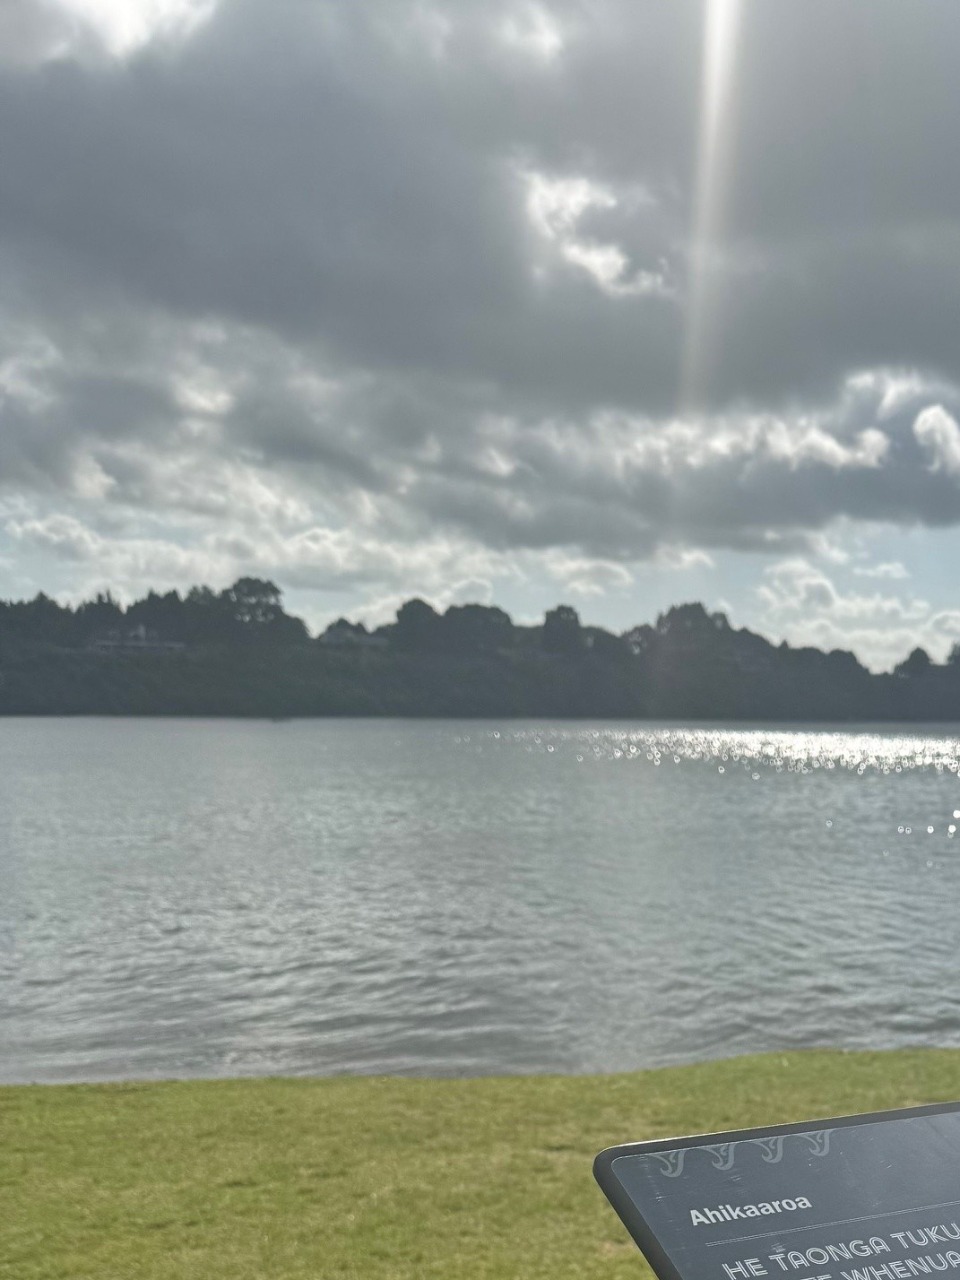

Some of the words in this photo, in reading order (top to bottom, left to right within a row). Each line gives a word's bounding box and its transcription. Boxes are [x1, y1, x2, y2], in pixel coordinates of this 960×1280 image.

[690, 1197, 812, 1226] Ahikaaroa
[721, 1258, 768, 1280] HE
[768, 1236, 891, 1271] TAONGA
